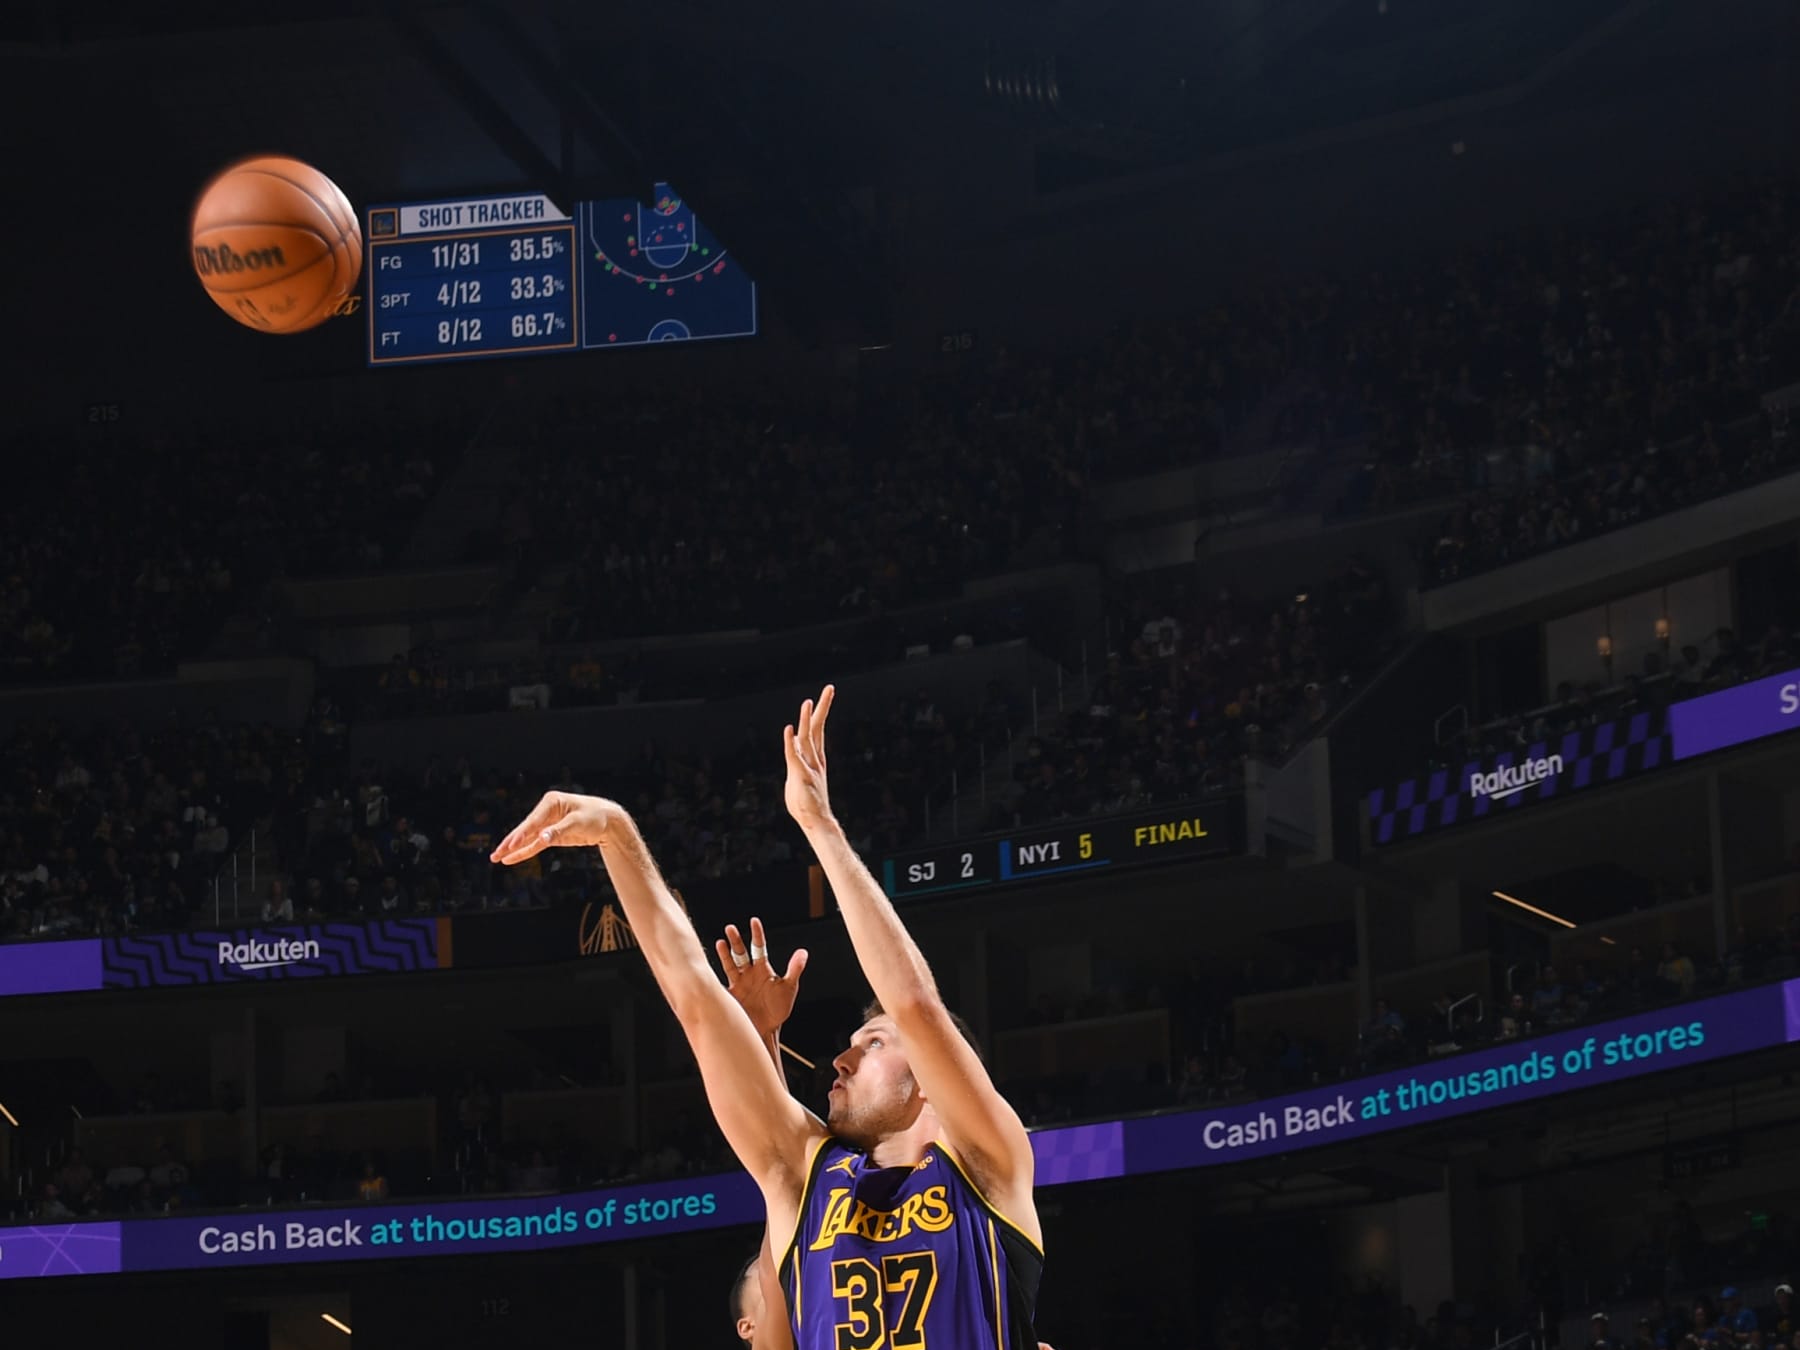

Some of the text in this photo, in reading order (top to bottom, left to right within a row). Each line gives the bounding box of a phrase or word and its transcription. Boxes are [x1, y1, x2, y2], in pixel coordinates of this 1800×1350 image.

[418, 199, 546, 228] SHOT TRACKER
[380, 236, 564, 270] FG 11/31 35.5%
[380, 293, 410, 308] 3PT
[437, 280, 482, 308] 4/12
[511, 275, 565, 300] 33.3%
[381, 312, 566, 346] FT 8/12 66.7%
[1469, 754, 1563, 798] Rakuten
[908, 819, 1208, 883] SJ 2 NYI 5 FINAL
[218, 938, 320, 965] Rakuten
[1202, 1021, 1705, 1150] Cash Back at thousands of stores
[198, 1193, 716, 1254] Cash Back at thousands of stores
[809, 1186, 954, 1251] LAKERS
